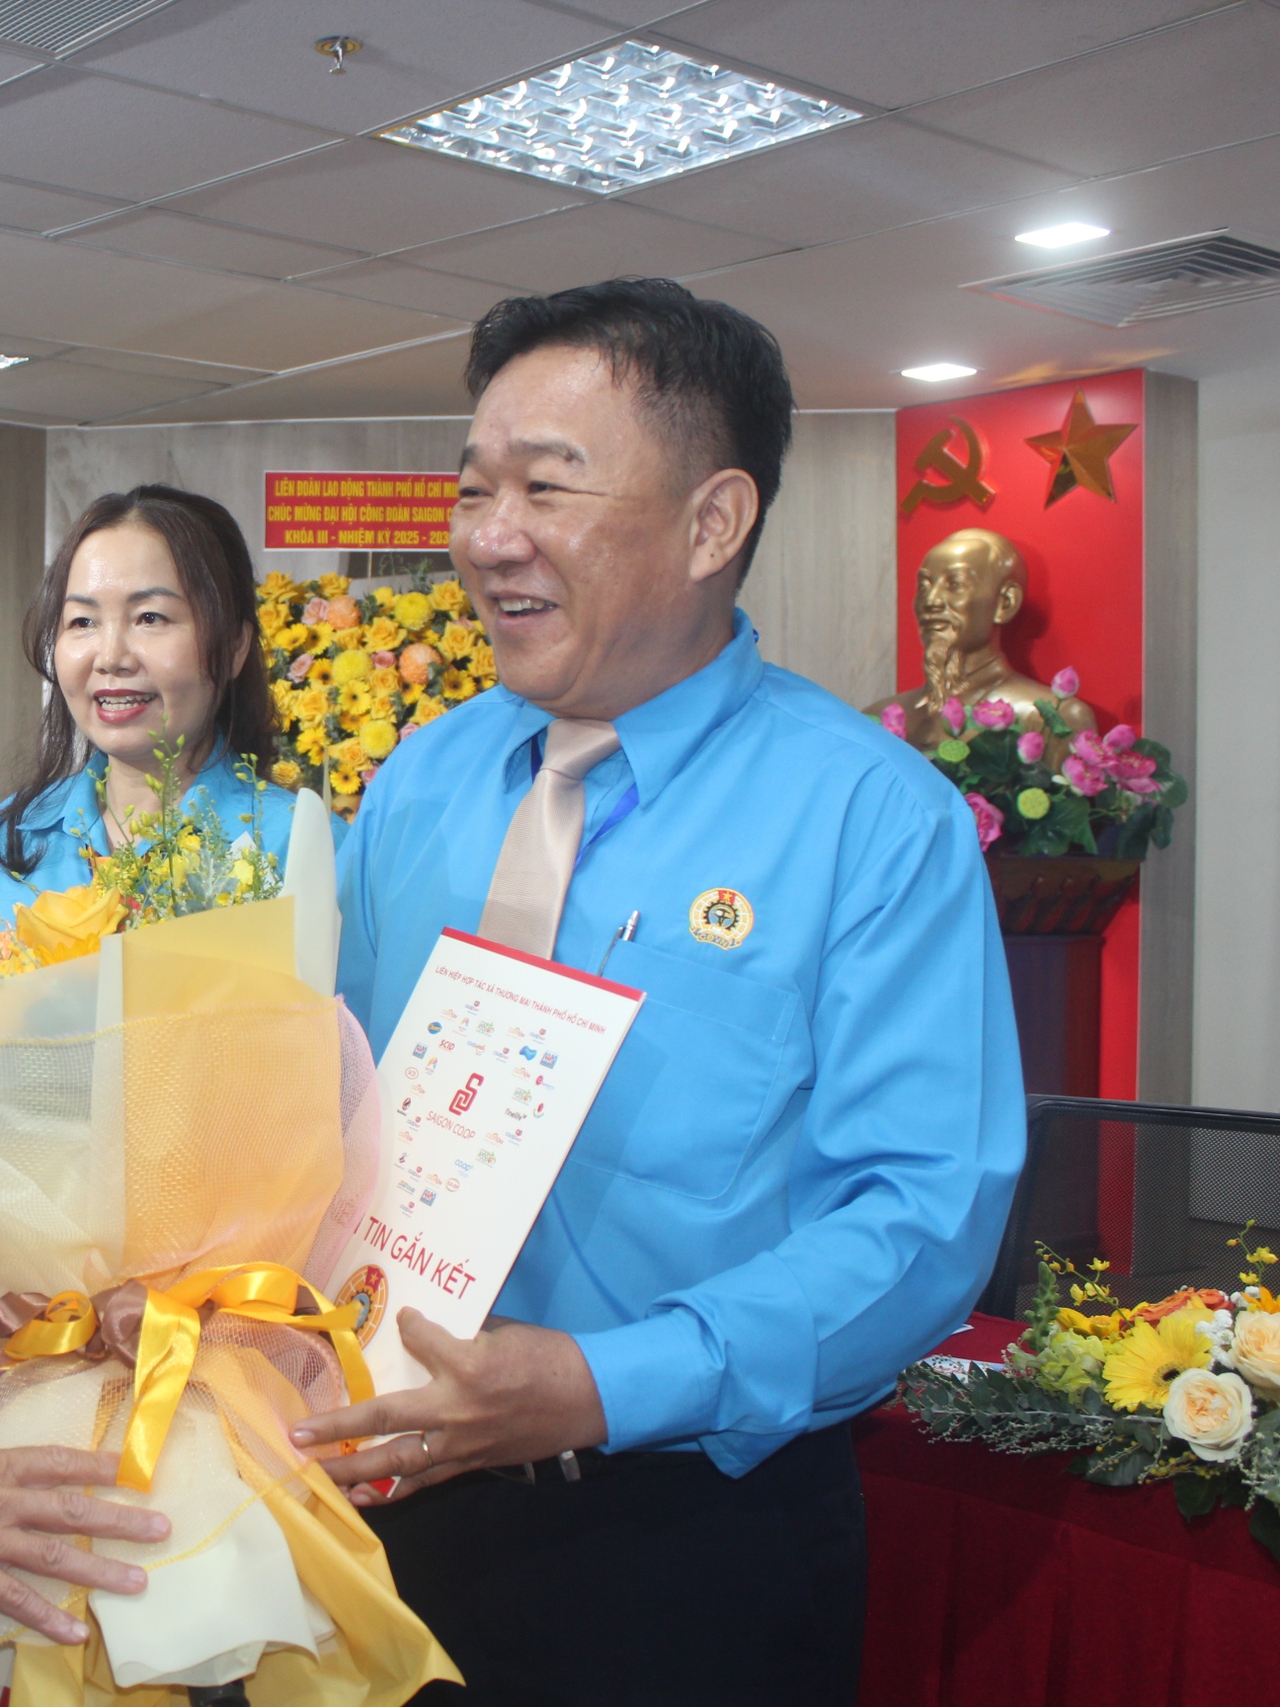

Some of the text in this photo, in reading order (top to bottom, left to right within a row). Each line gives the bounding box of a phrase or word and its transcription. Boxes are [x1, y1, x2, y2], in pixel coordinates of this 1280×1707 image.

[275, 477, 295, 496] LIÊN
[297, 477, 320, 496] ĐOÀN
[323, 480, 339, 496] LAO
[341, 477, 365, 500] ĐỘNG
[366, 477, 394, 497] THÀNH
[427, 478, 442, 497] CHÍ
[444, 482, 459, 498] MIN
[268, 502, 292, 522] CHÚC
[294, 502, 321, 522] MỪNG
[324, 506, 339, 525] ĐẠI
[342, 503, 357, 525] HỘI
[360, 503, 384, 522] CÔNG
[386, 503, 410, 522] ĐOÀN
[412, 506, 444, 522] SAIGON
[285, 527, 314, 544] KHÓA
[317, 530, 328, 544] III
[338, 527, 375, 547] NHIỆM
[378, 527, 391, 544] KỲ
[394, 530, 419, 545] 2025
[429, 530, 450, 545] 203
[439, 1039, 455, 1051] SCID
[426, 1110, 455, 1131] SAIGON
[364, 1216, 476, 1300] TIN GẮN KẾT
